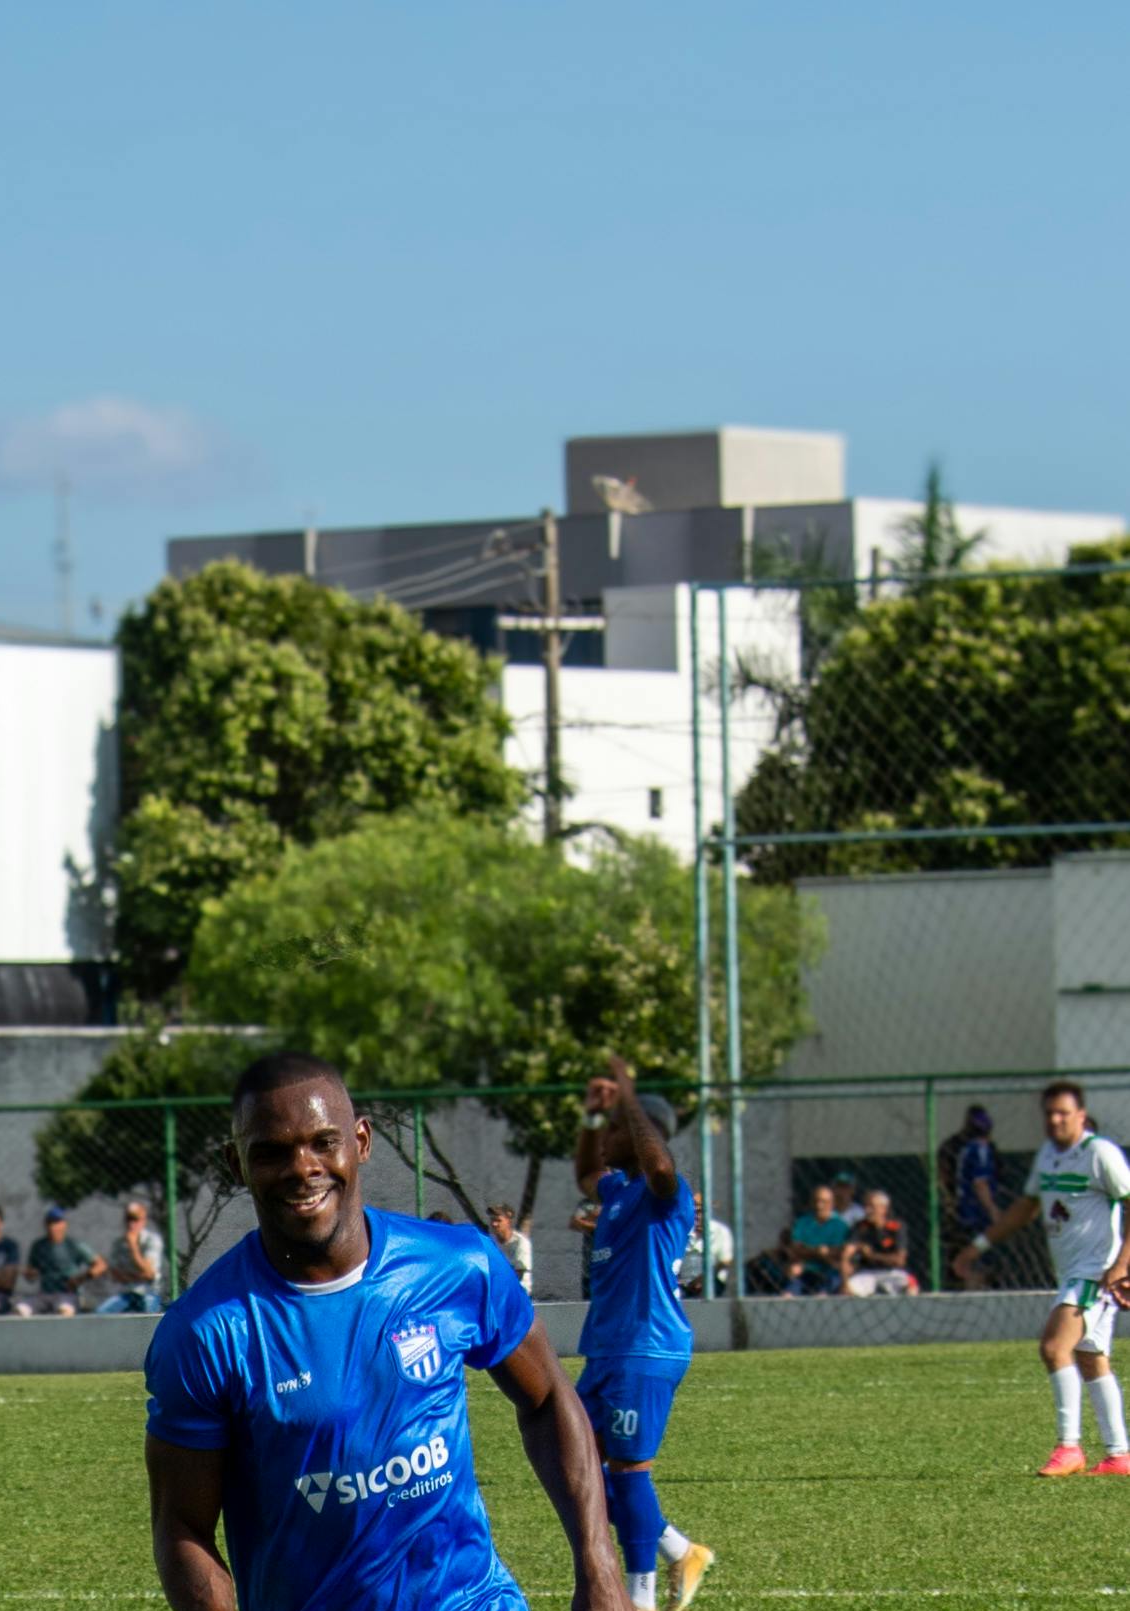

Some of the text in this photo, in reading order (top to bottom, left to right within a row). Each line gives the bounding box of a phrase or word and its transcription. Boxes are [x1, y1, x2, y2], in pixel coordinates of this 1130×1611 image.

[611, 1409, 638, 1436] 20
[335, 1436, 449, 1504] SICOOB
[387, 1470, 453, 1508] Ceditiros
